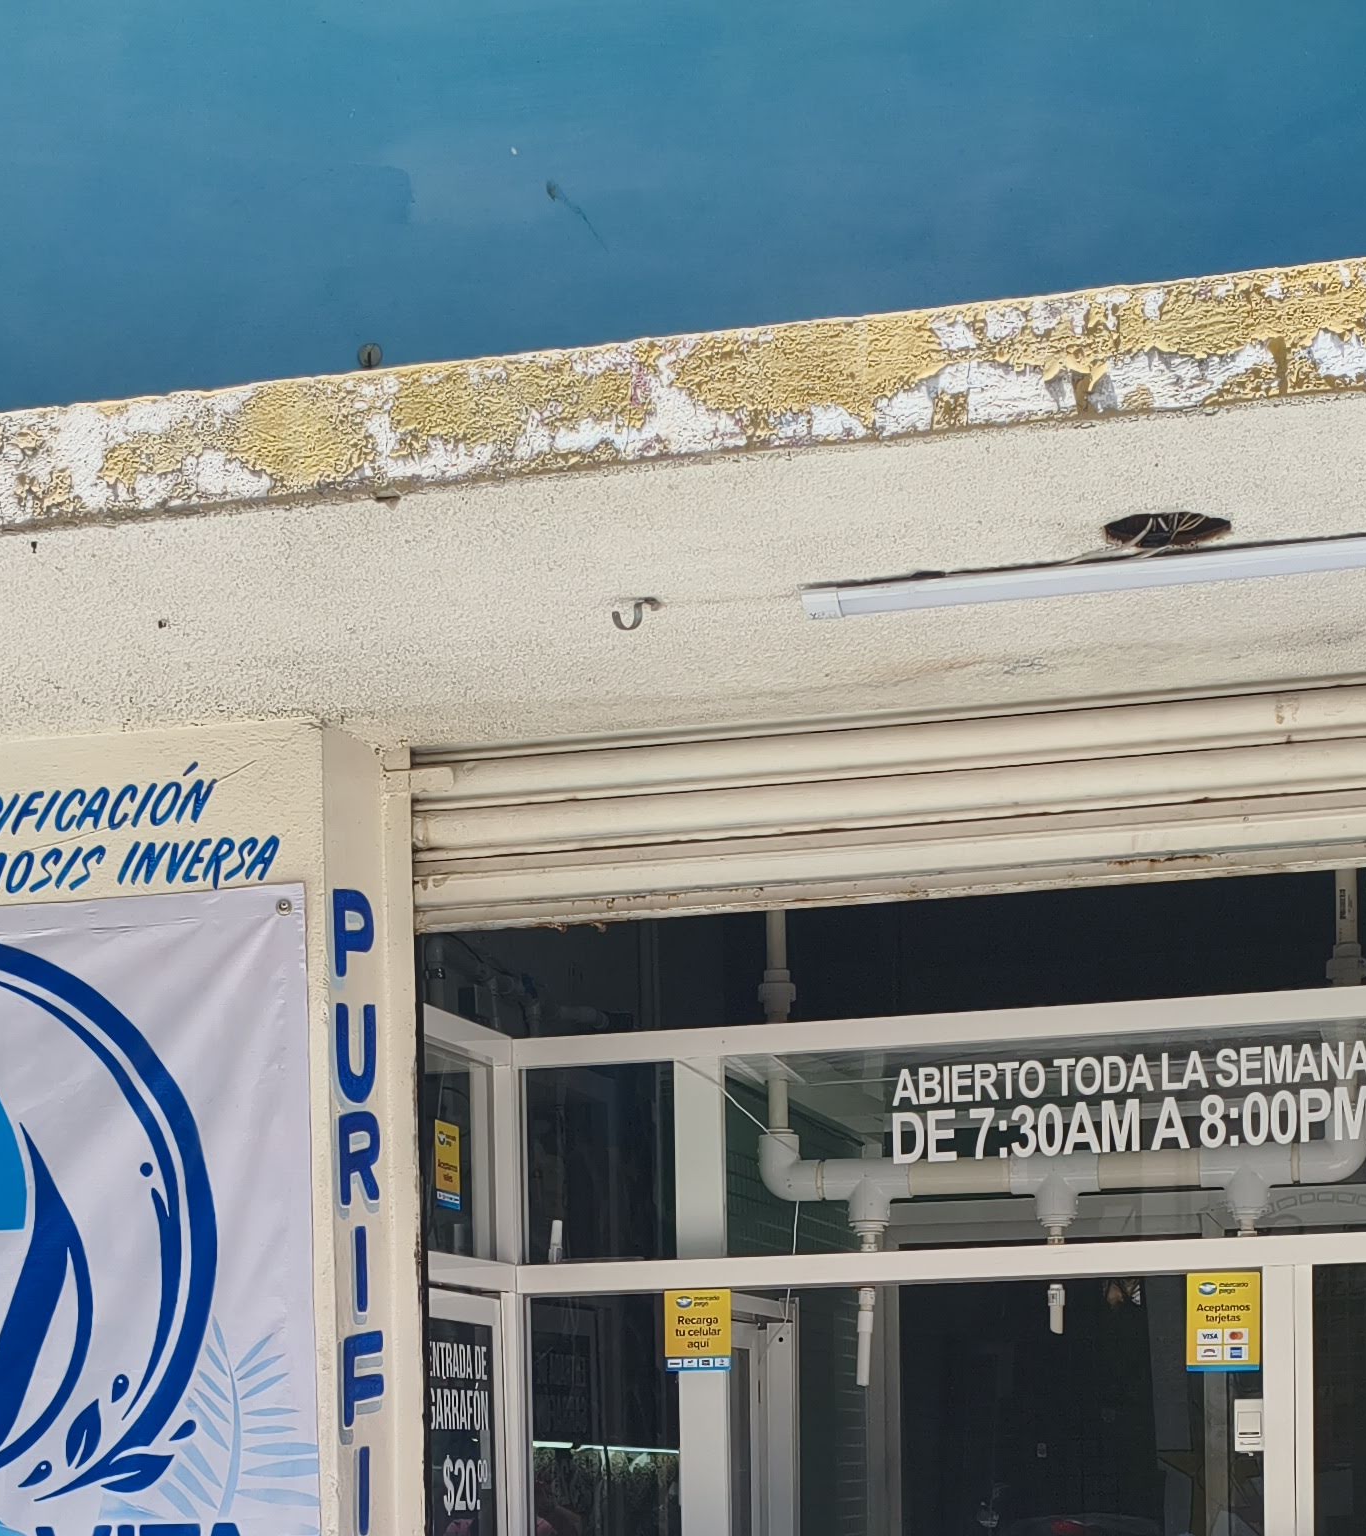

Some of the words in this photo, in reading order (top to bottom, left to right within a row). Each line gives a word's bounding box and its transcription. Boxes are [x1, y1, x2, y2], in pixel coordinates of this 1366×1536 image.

[117, 834, 281, 890] INVERSA
[892, 1060, 1046, 1107] ABIERTO
[1053, 1054, 1154, 1096] TODA
[1161, 1051, 1209, 1090] LA
[892, 1109, 957, 1164] DE
[969, 1099, 1140, 1160] 7:30AM
[1150, 1097, 1190, 1150] A
[1197, 1303, 1250, 1313] Aceptamos
[1205, 1314, 1241, 1324] tarjetas
[675, 1328, 685, 1336] tu
[688, 1327, 721, 1336] celular
[677, 1316, 718, 1326] Recarga
[475, 1345, 488, 1380] DE
